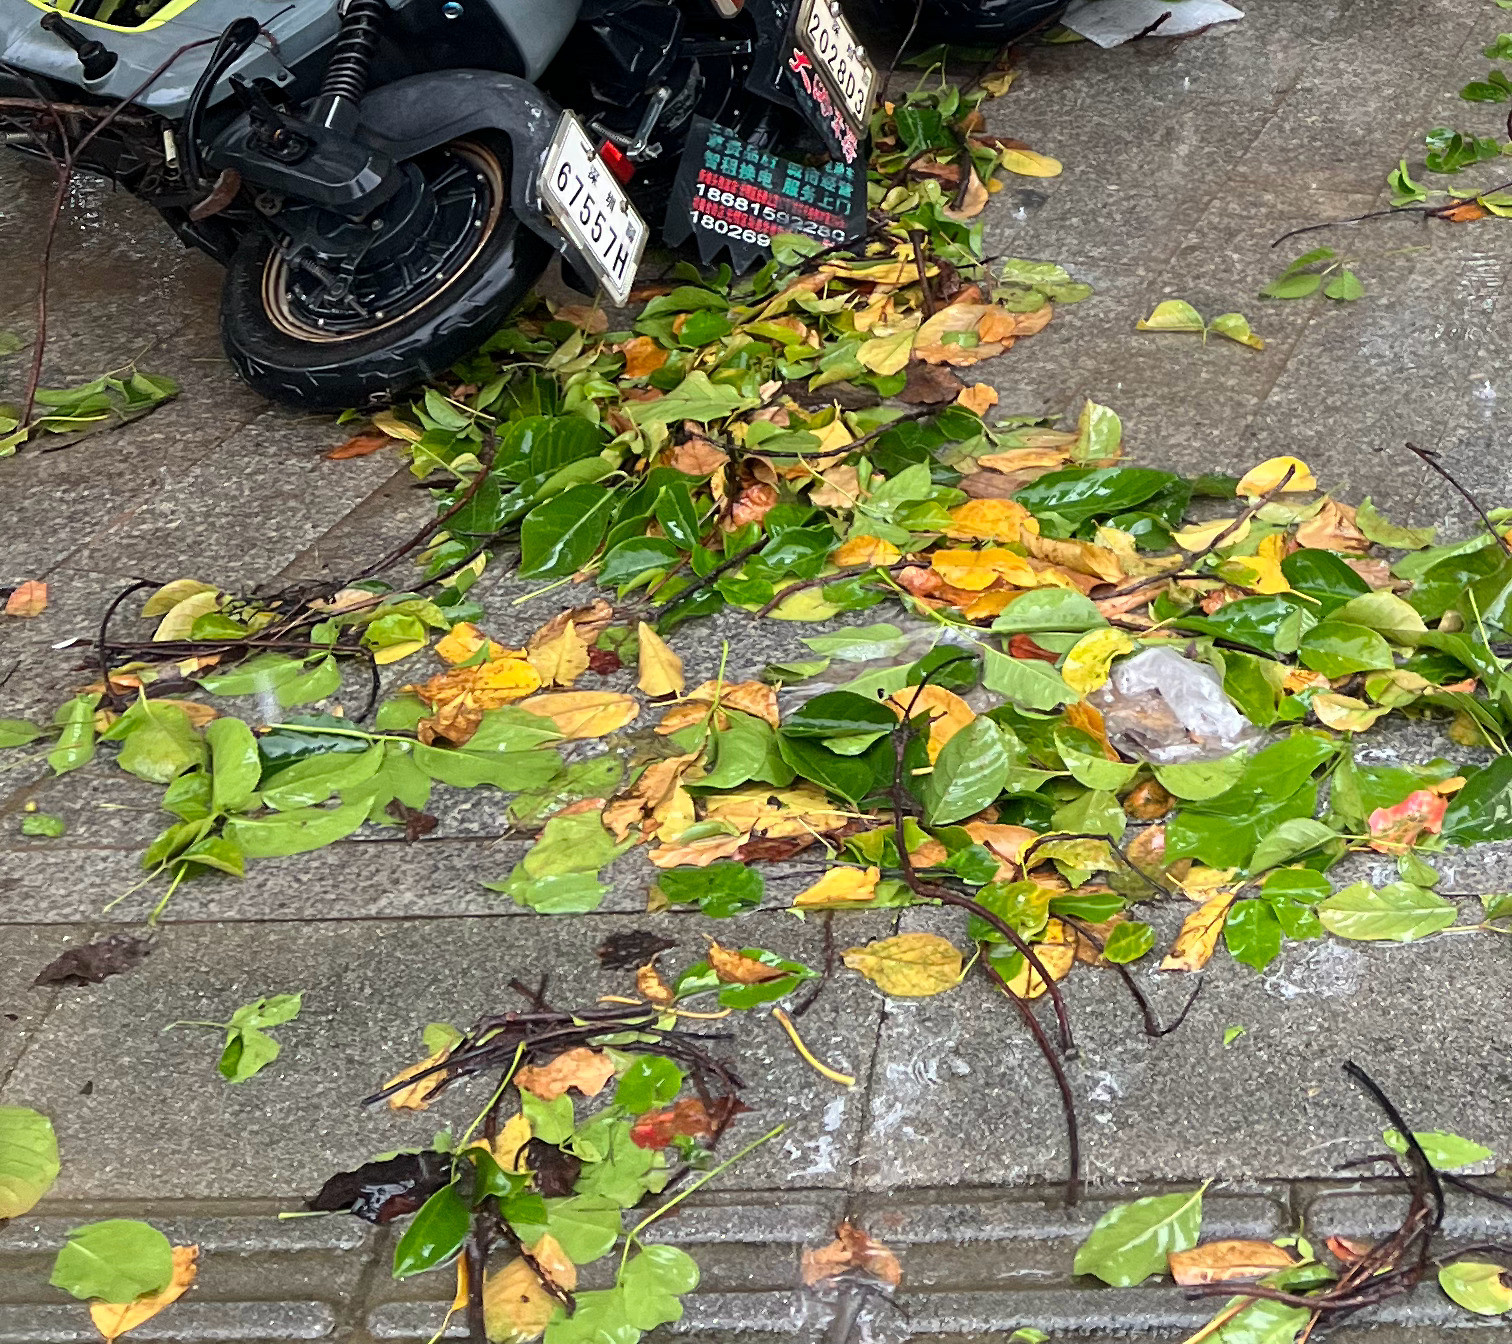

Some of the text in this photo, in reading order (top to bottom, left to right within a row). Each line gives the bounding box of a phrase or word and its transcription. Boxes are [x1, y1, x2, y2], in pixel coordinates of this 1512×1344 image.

[809, 13, 865, 115] 2028D3
[557, 161, 629, 280] 67557H
[695, 183, 846, 243] 18681592280
